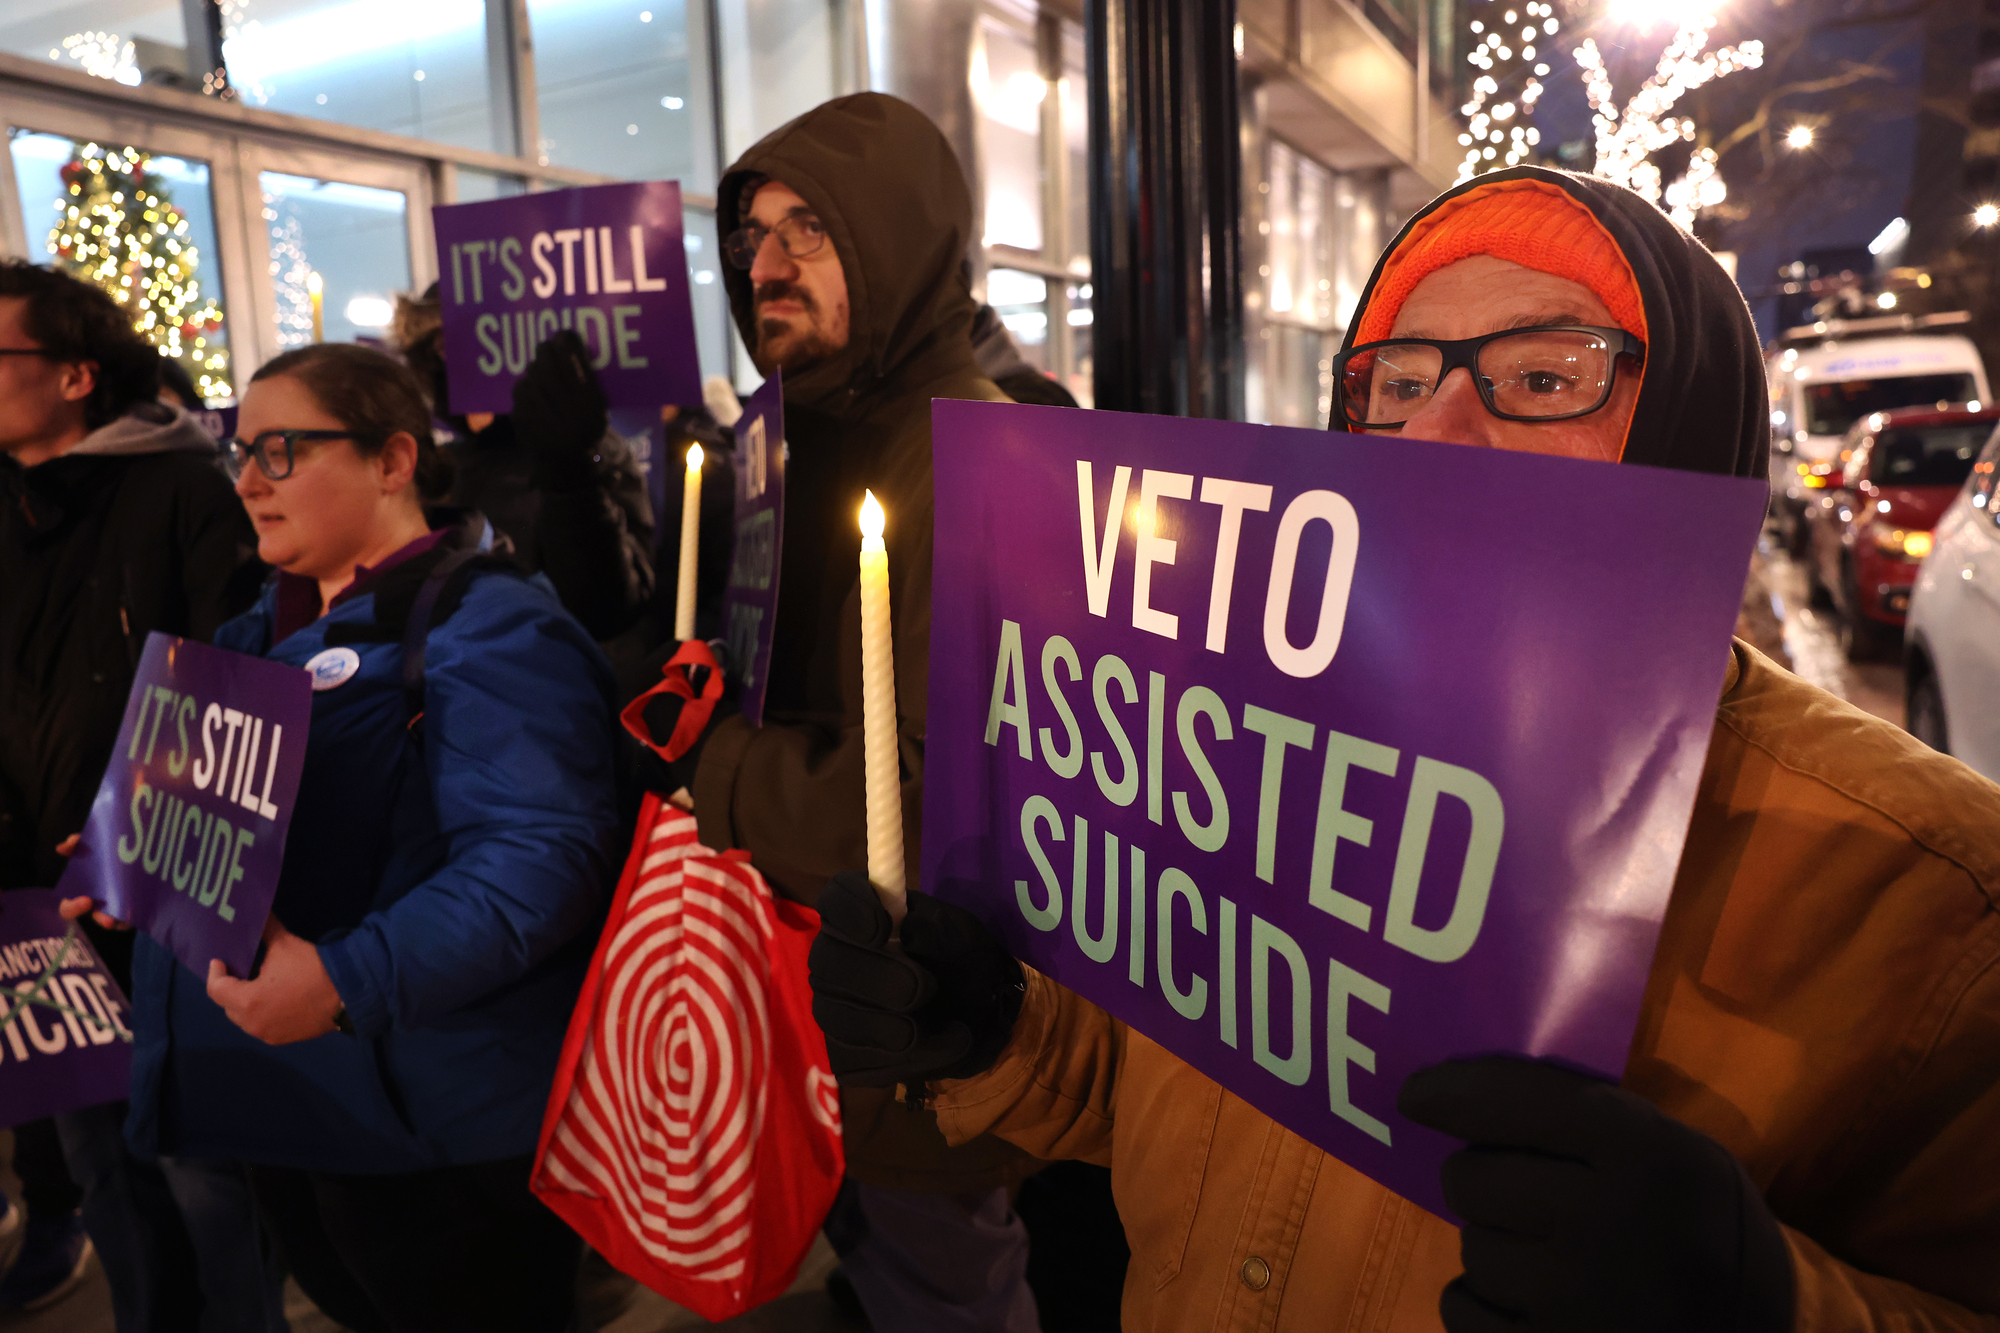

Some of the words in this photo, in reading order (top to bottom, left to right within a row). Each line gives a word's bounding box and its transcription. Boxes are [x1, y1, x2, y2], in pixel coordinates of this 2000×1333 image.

[451, 237, 526, 305] IT'S
[531, 225, 667, 299] STILL
[1076, 459, 1360, 678] VETO
[127, 684, 196, 777] IT'S
[193, 702, 282, 822] STILL
[984, 619, 1505, 964] ASSISTED
[118, 785, 256, 924] SUICIDE
[0, 973, 134, 1066] ICIDE
[1014, 794, 1392, 1147] SUICIDE
